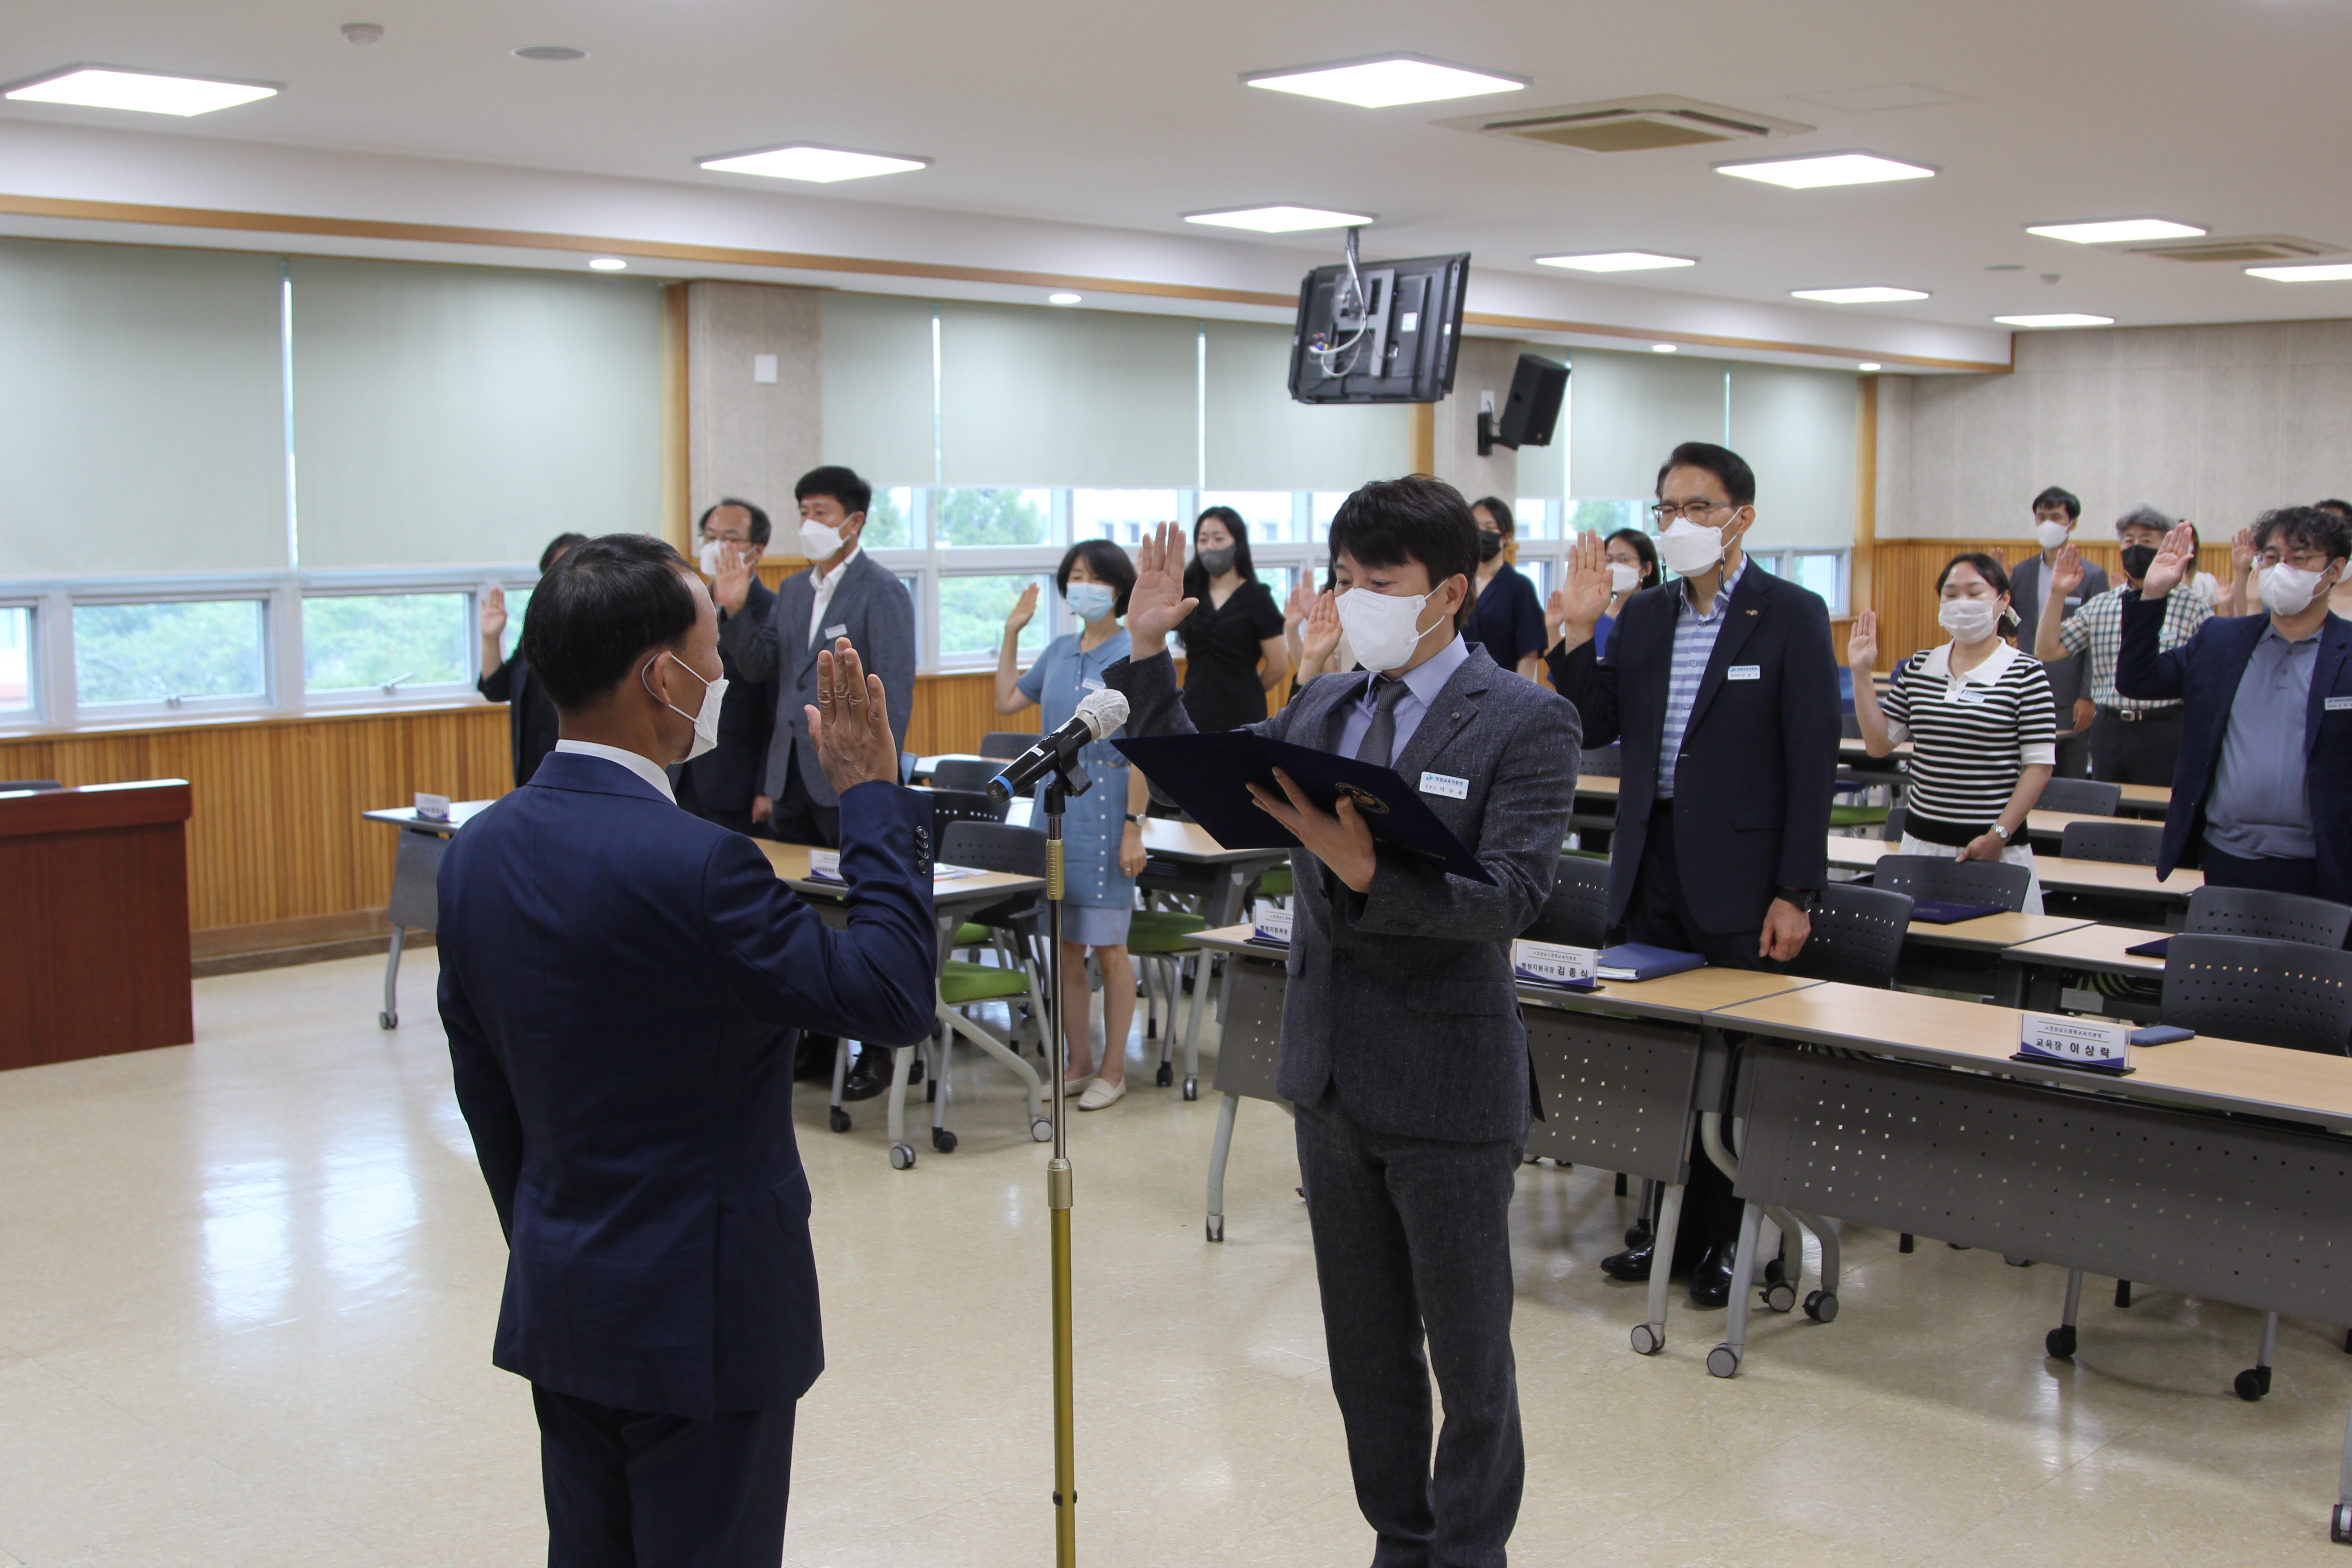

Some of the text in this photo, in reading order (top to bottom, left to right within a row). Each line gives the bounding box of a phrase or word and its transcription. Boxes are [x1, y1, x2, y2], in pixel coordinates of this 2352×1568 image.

[1436, 777, 1463, 786] 창원교육지원청
[1521, 962, 1554, 974] 행정지원국장
[2049, 1025, 2102, 1039] 경상남도창원교육지원청
[2036, 1038, 2062, 1051] 교육장
